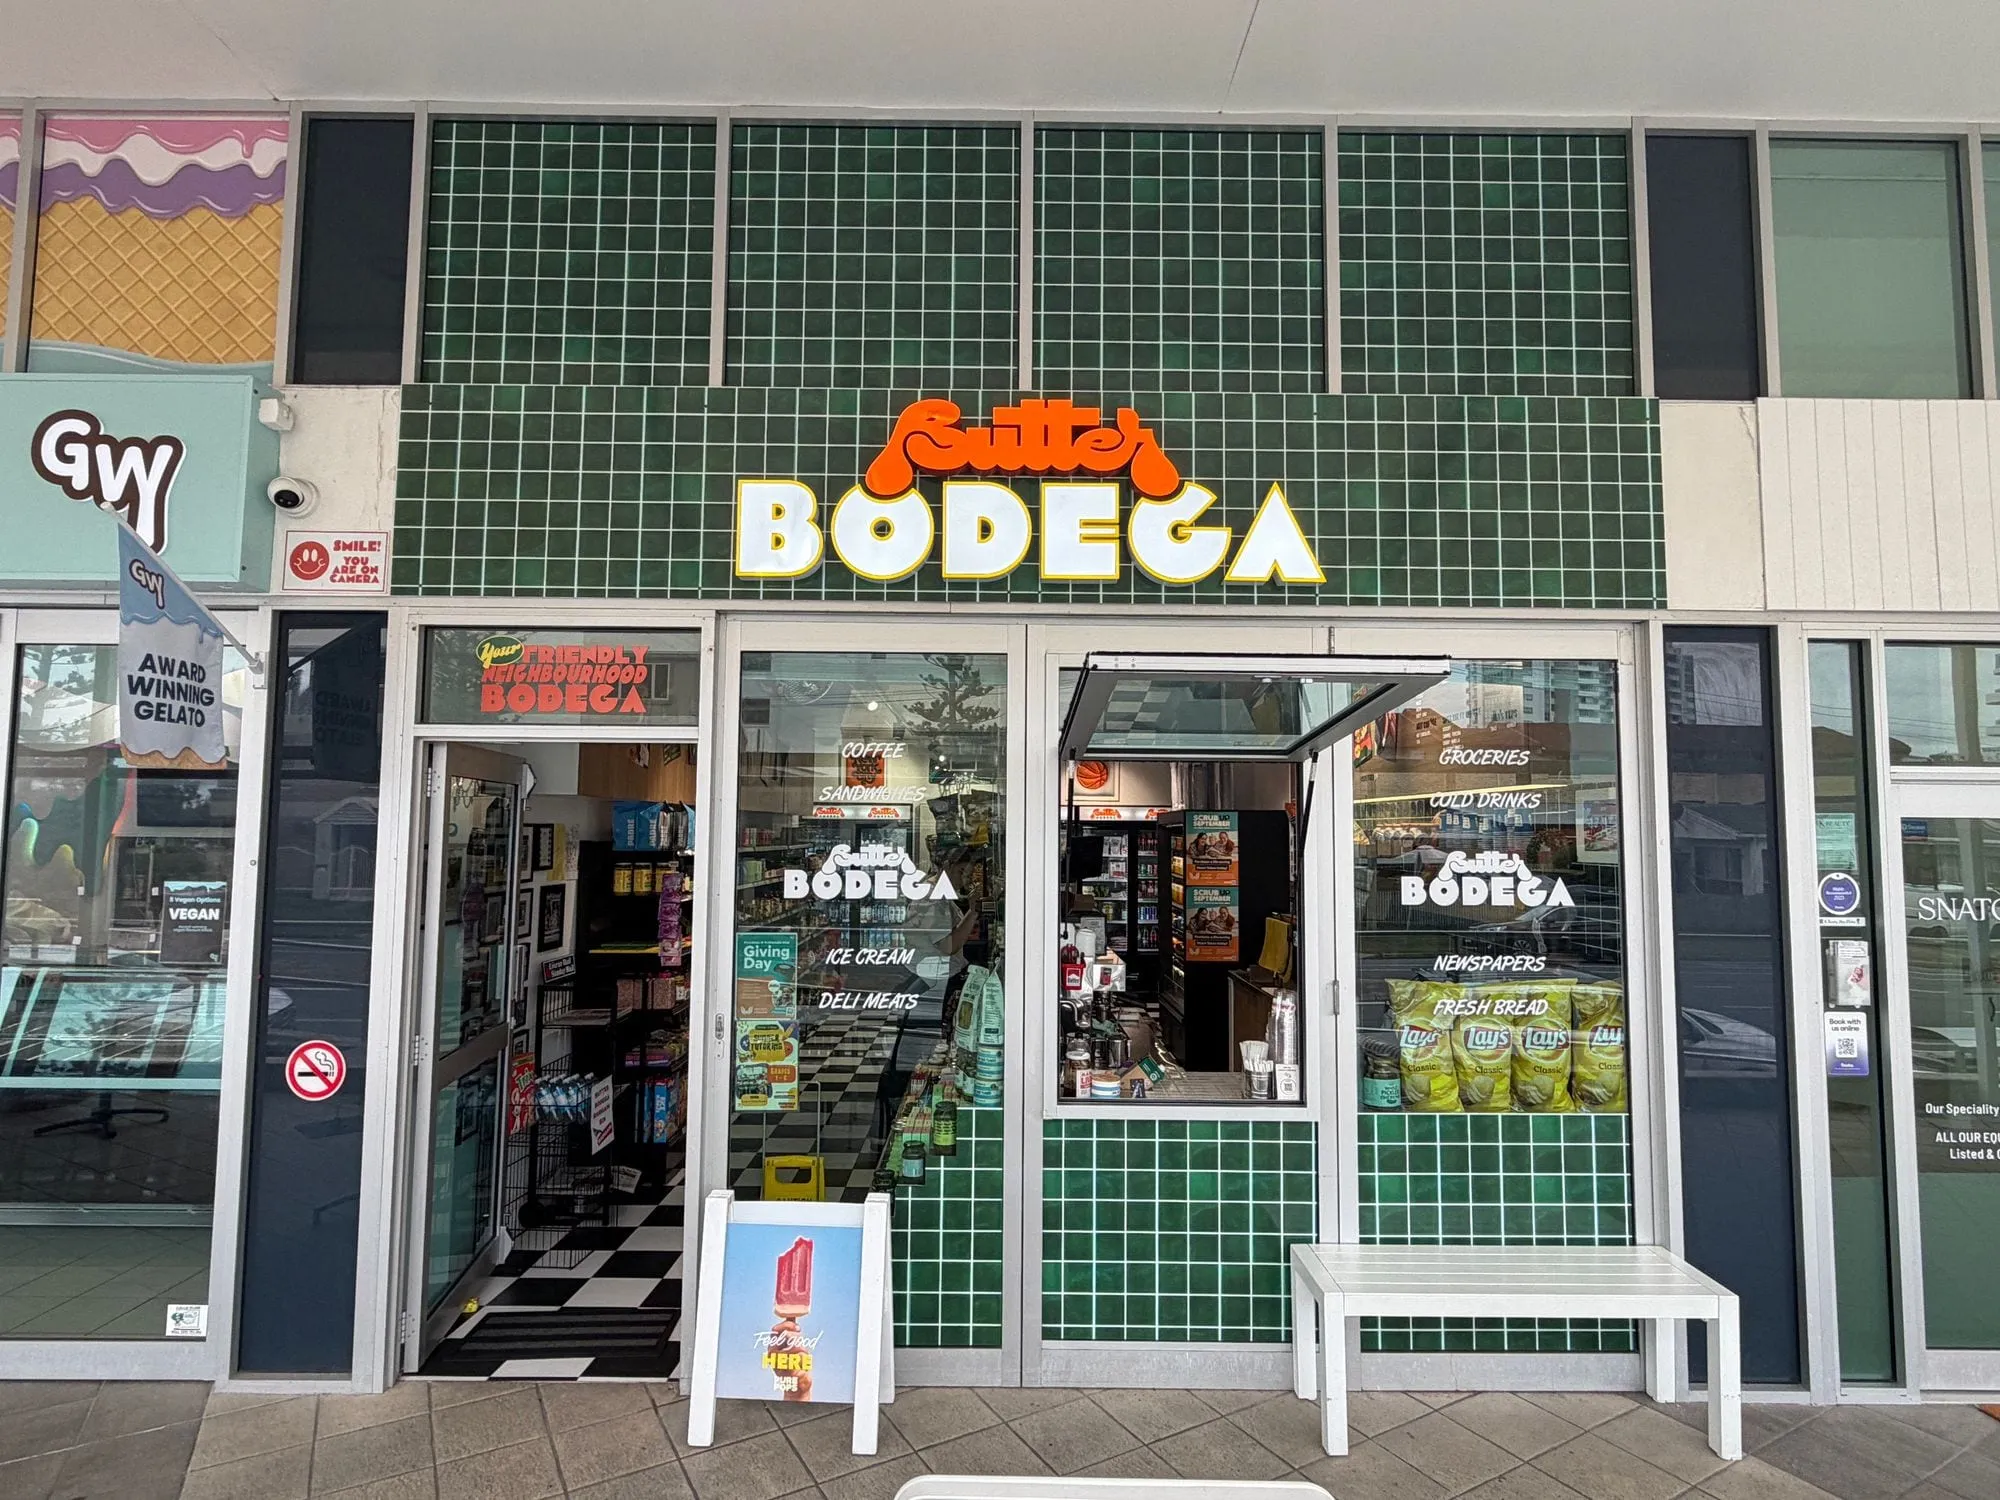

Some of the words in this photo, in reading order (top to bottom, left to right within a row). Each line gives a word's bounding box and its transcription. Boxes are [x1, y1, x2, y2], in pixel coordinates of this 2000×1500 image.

[865, 399, 1180, 496] Butter
[735, 480, 1327, 585] BODEGA
[333, 539, 381, 552] SMILE!
[343, 556, 369, 566] YOU
[330, 574, 380, 584] CAMERA
[333, 566, 356, 575] ARE
[361, 566, 379, 575] ON
[480, 642, 522, 669] Your
[523, 644, 649, 664] FRIENDLY
[138, 653, 206, 684] AWARD
[481, 663, 648, 685] NEIGHBOURHOOD
[127, 674, 215, 707] WINNING
[481, 684, 647, 713] BODEGA
[134, 700, 206, 728] GELATO
[842, 742, 907, 758] COFFEE
[1439, 749, 1531, 766] GROCERIES
[819, 785, 928, 801] SANDWICHES
[1430, 792, 1474, 809] COLD
[1477, 792, 1541, 809] DRINKS
[822, 844, 917, 875] Butter
[1438, 851, 1534, 882] Butter
[783, 869, 959, 900] BODEGA
[1401, 876, 1576, 907] BODEGA
[196, 896, 221, 904] Options
[169, 908, 220, 921] VEGAN
[743, 945, 790, 960] Giving
[825, 948, 853, 965] ICE
[854, 948, 916, 965] CREAM
[743, 957, 772, 972] Day
[1434, 955, 1547, 972] NEWSPAPERS
[819, 992, 859, 1010] DELI
[862, 992, 920, 1010] MEATS
[1433, 999, 1490, 1016] FRESH
[1494, 999, 1549, 1016] BREAD
[1467, 1026, 1511, 1050] Lay's
[1525, 1026, 1568, 1050] Lay's
[1408, 1063, 1436, 1072] Classic
[1475, 1065, 1503, 1074] Classic
[1533, 1065, 1563, 1074] Classic
[1925, 1103, 1945, 1114] Our
[1946, 1103, 2000, 1117] Speciality
[1936, 1132, 1957, 1143] ALL
[1959, 1132, 1982, 1143] OUR
[1949, 1148, 1985, 1160] Listed
[1986, 1148, 1995, 1160] &
[753, 1330, 787, 1350] Feel
[783, 1330, 823, 1351] good
[762, 1352, 812, 1370] HERE
[774, 1376, 799, 1384] PURE
[774, 1383, 799, 1392] POPS
